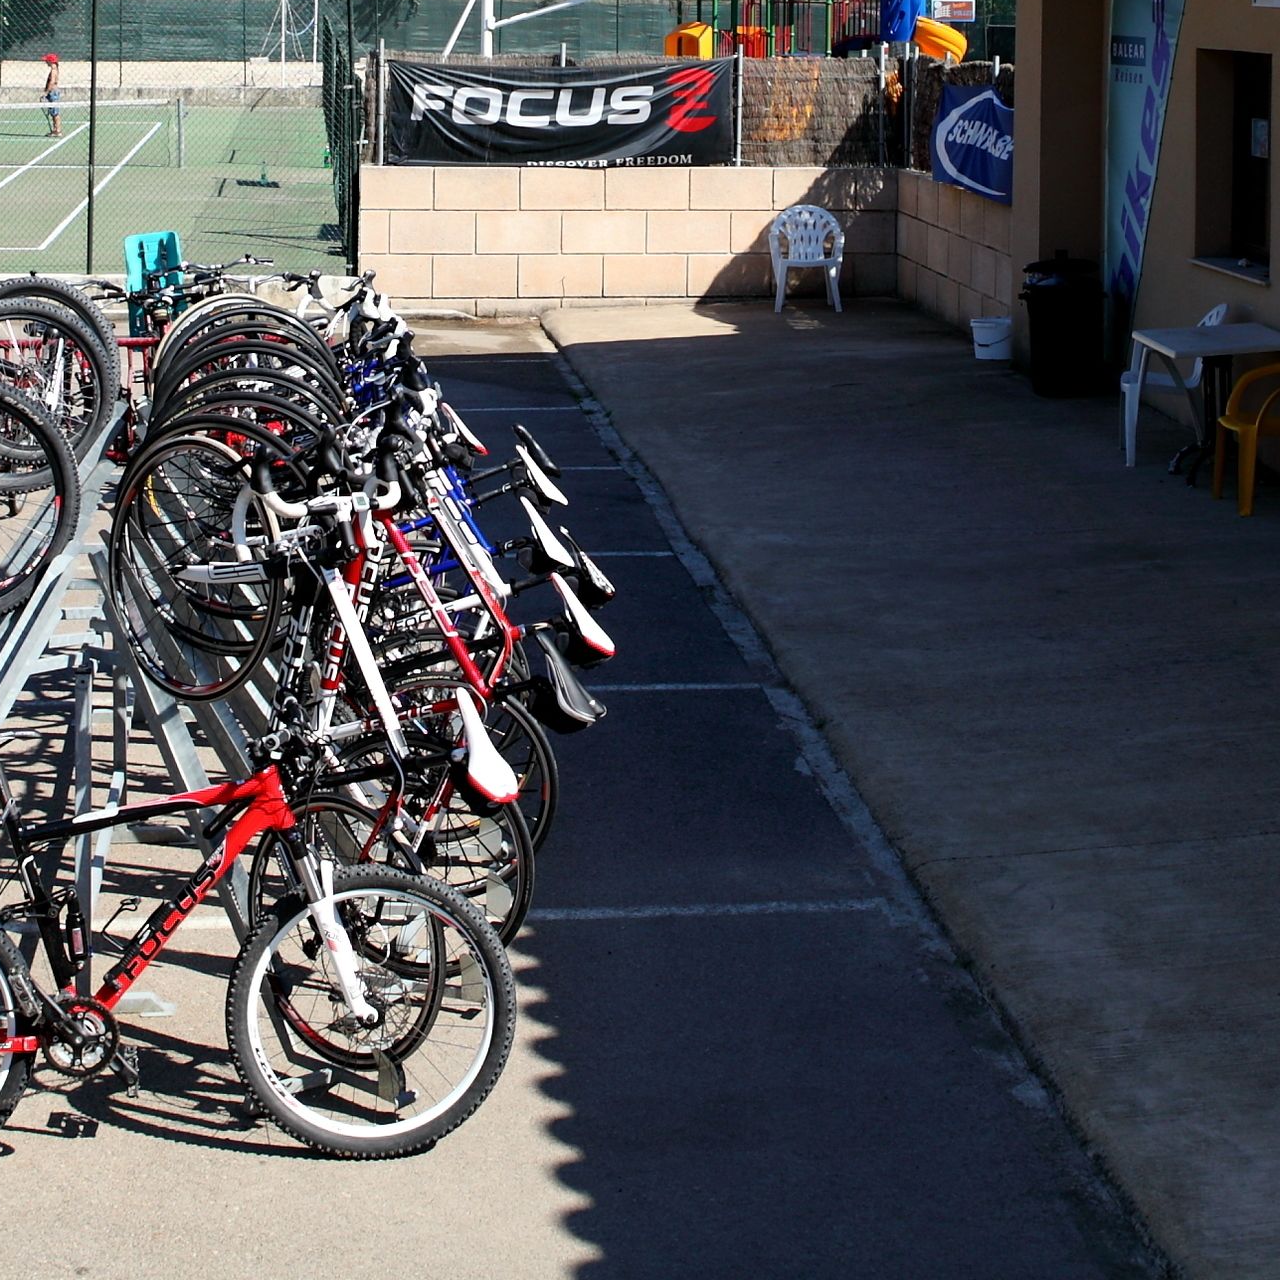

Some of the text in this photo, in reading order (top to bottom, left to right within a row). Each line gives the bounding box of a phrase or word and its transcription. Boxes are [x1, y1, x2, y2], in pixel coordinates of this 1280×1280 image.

[1112, 41, 1145, 59] BALEAR
[1115, 67, 1143, 84] Reisen
[411, 83, 654, 127] FOCUS
[616, 154, 693, 167] FREEDOM
[356, 540, 385, 623] OCUS
[397, 605, 455, 628] FOCS
